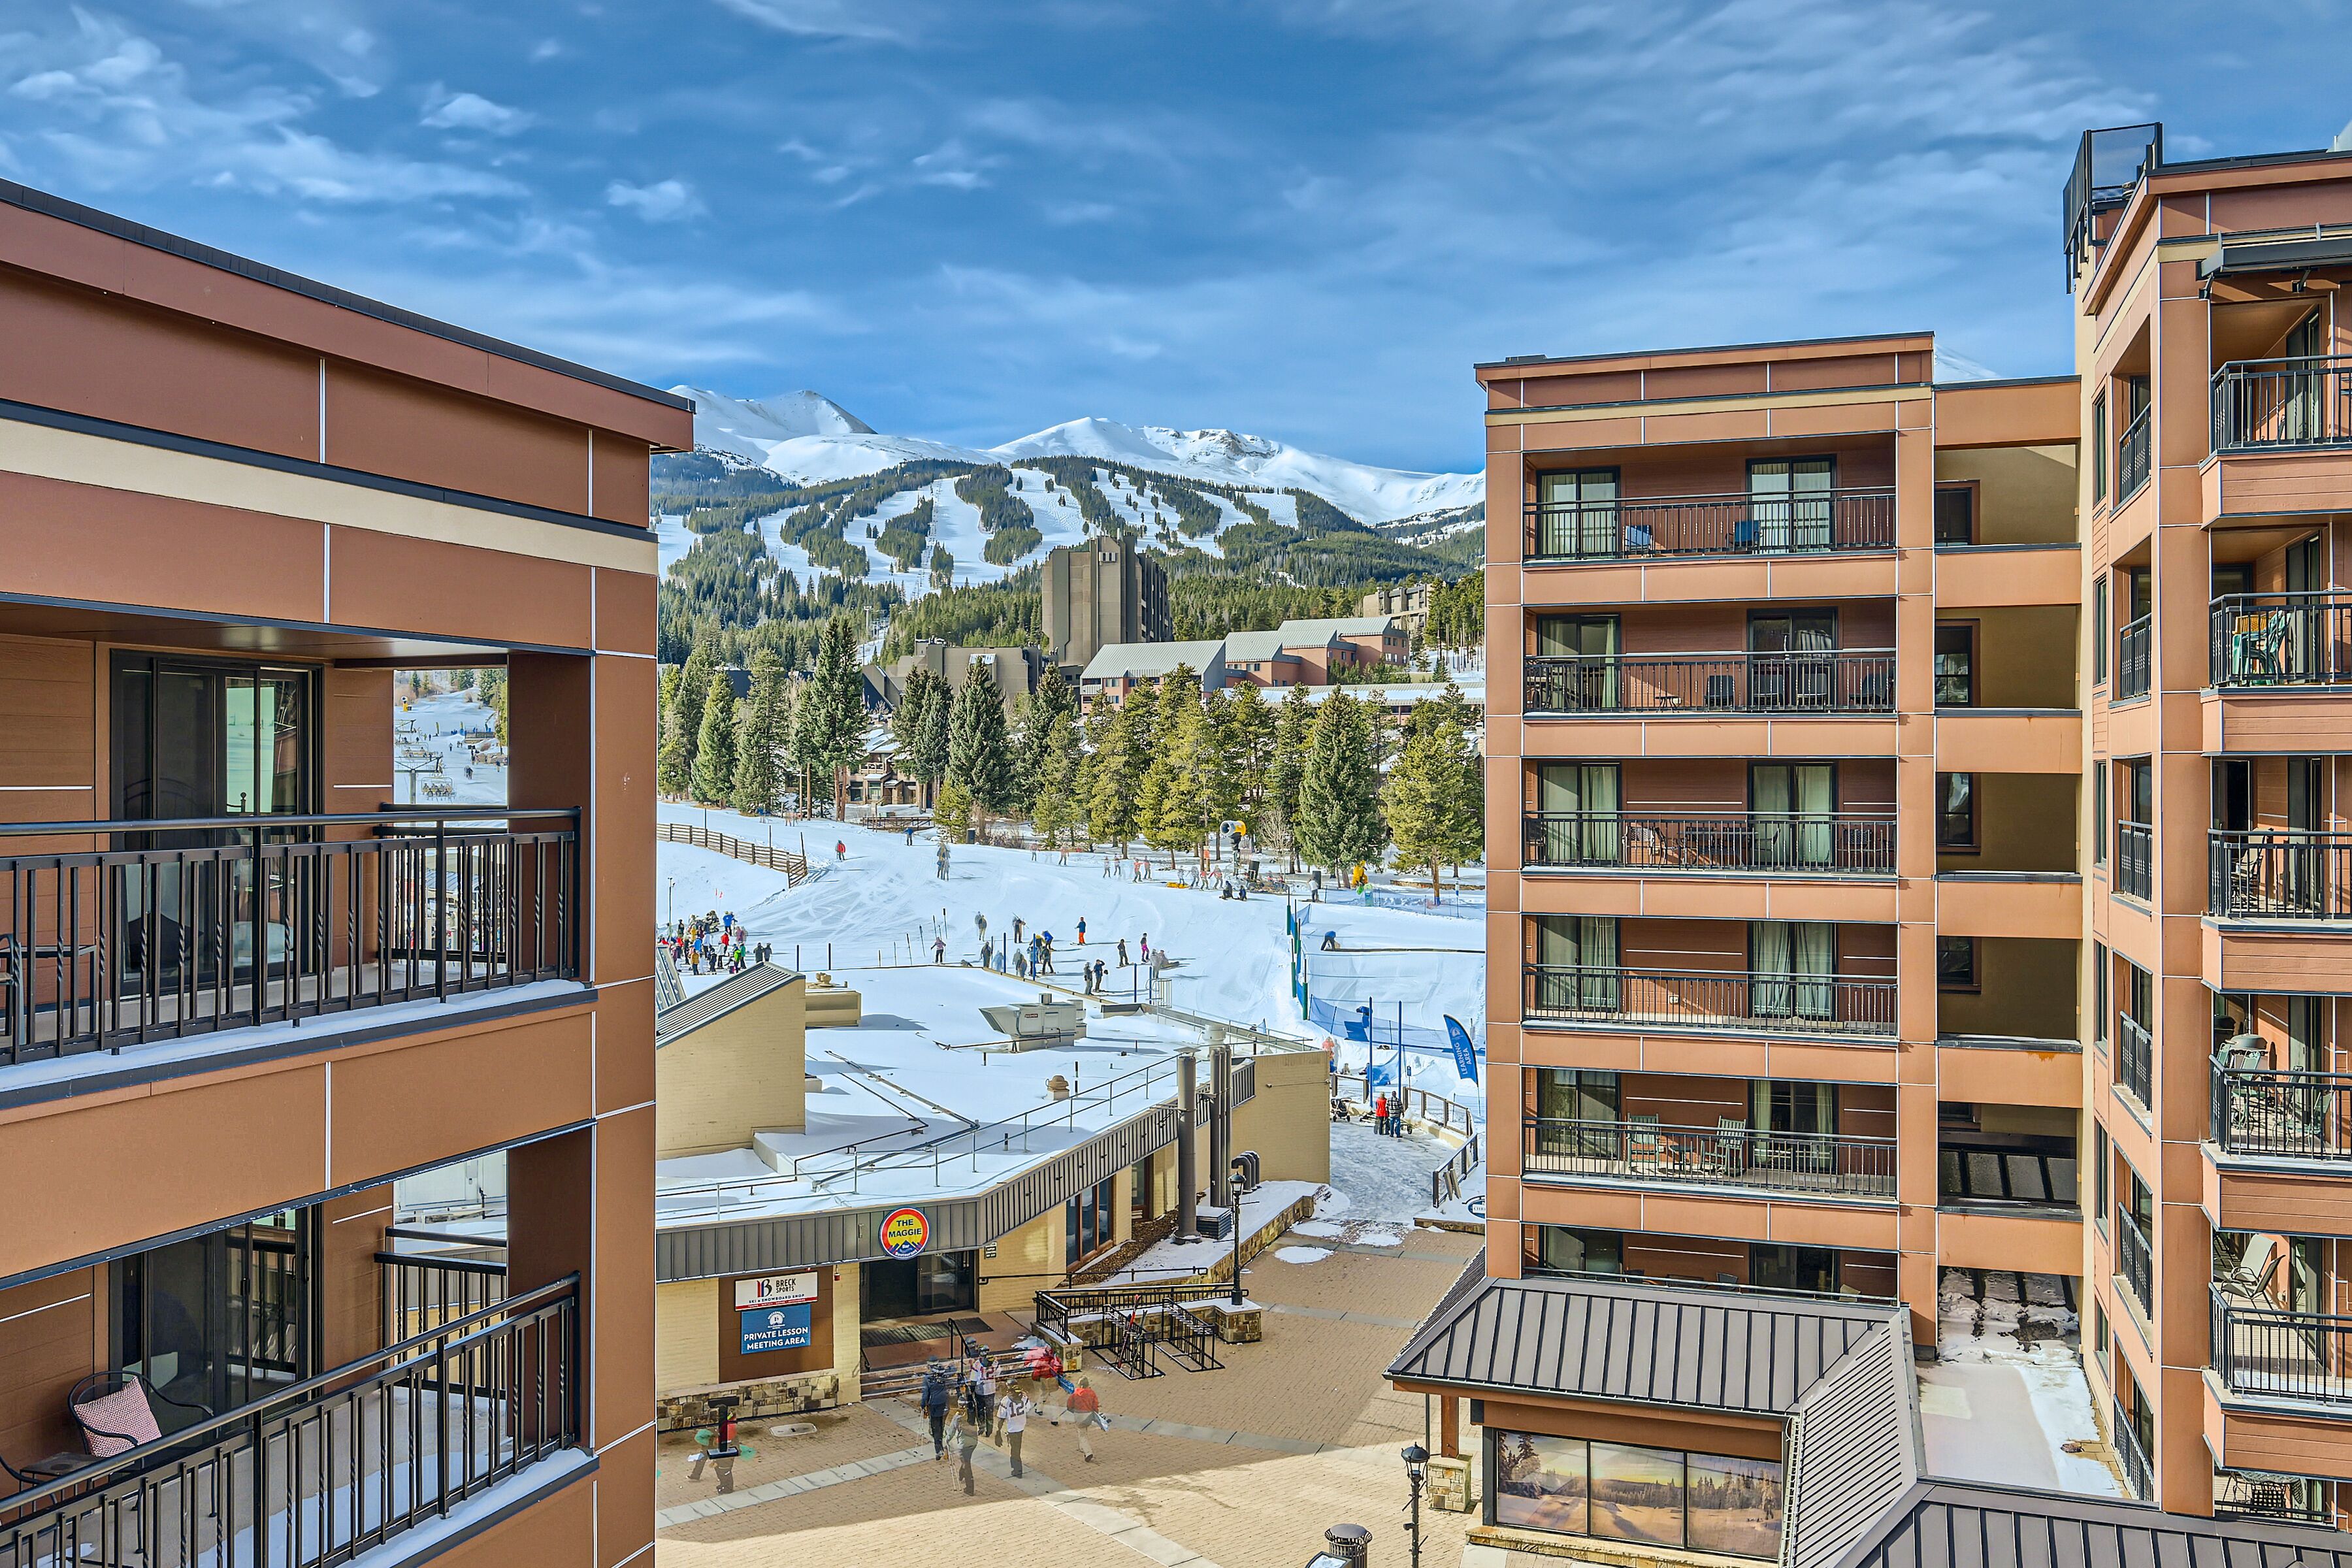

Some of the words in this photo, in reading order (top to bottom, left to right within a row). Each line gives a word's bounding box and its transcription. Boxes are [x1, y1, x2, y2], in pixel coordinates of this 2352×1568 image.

[1454, 1042, 1468, 1075] LEARNING
[1463, 1047, 1472, 1065] AREA
[889, 1228, 922, 1237] MAGGIE
[776, 1278, 796, 1288] BRECK
[744, 1330, 776, 1341] PRIVATE
[778, 1327, 808, 1337] LESSON
[747, 1339, 783, 1350] MEETING
[785, 1337, 805, 1346] AREA
[1009, 1400, 1024, 1418] 12
